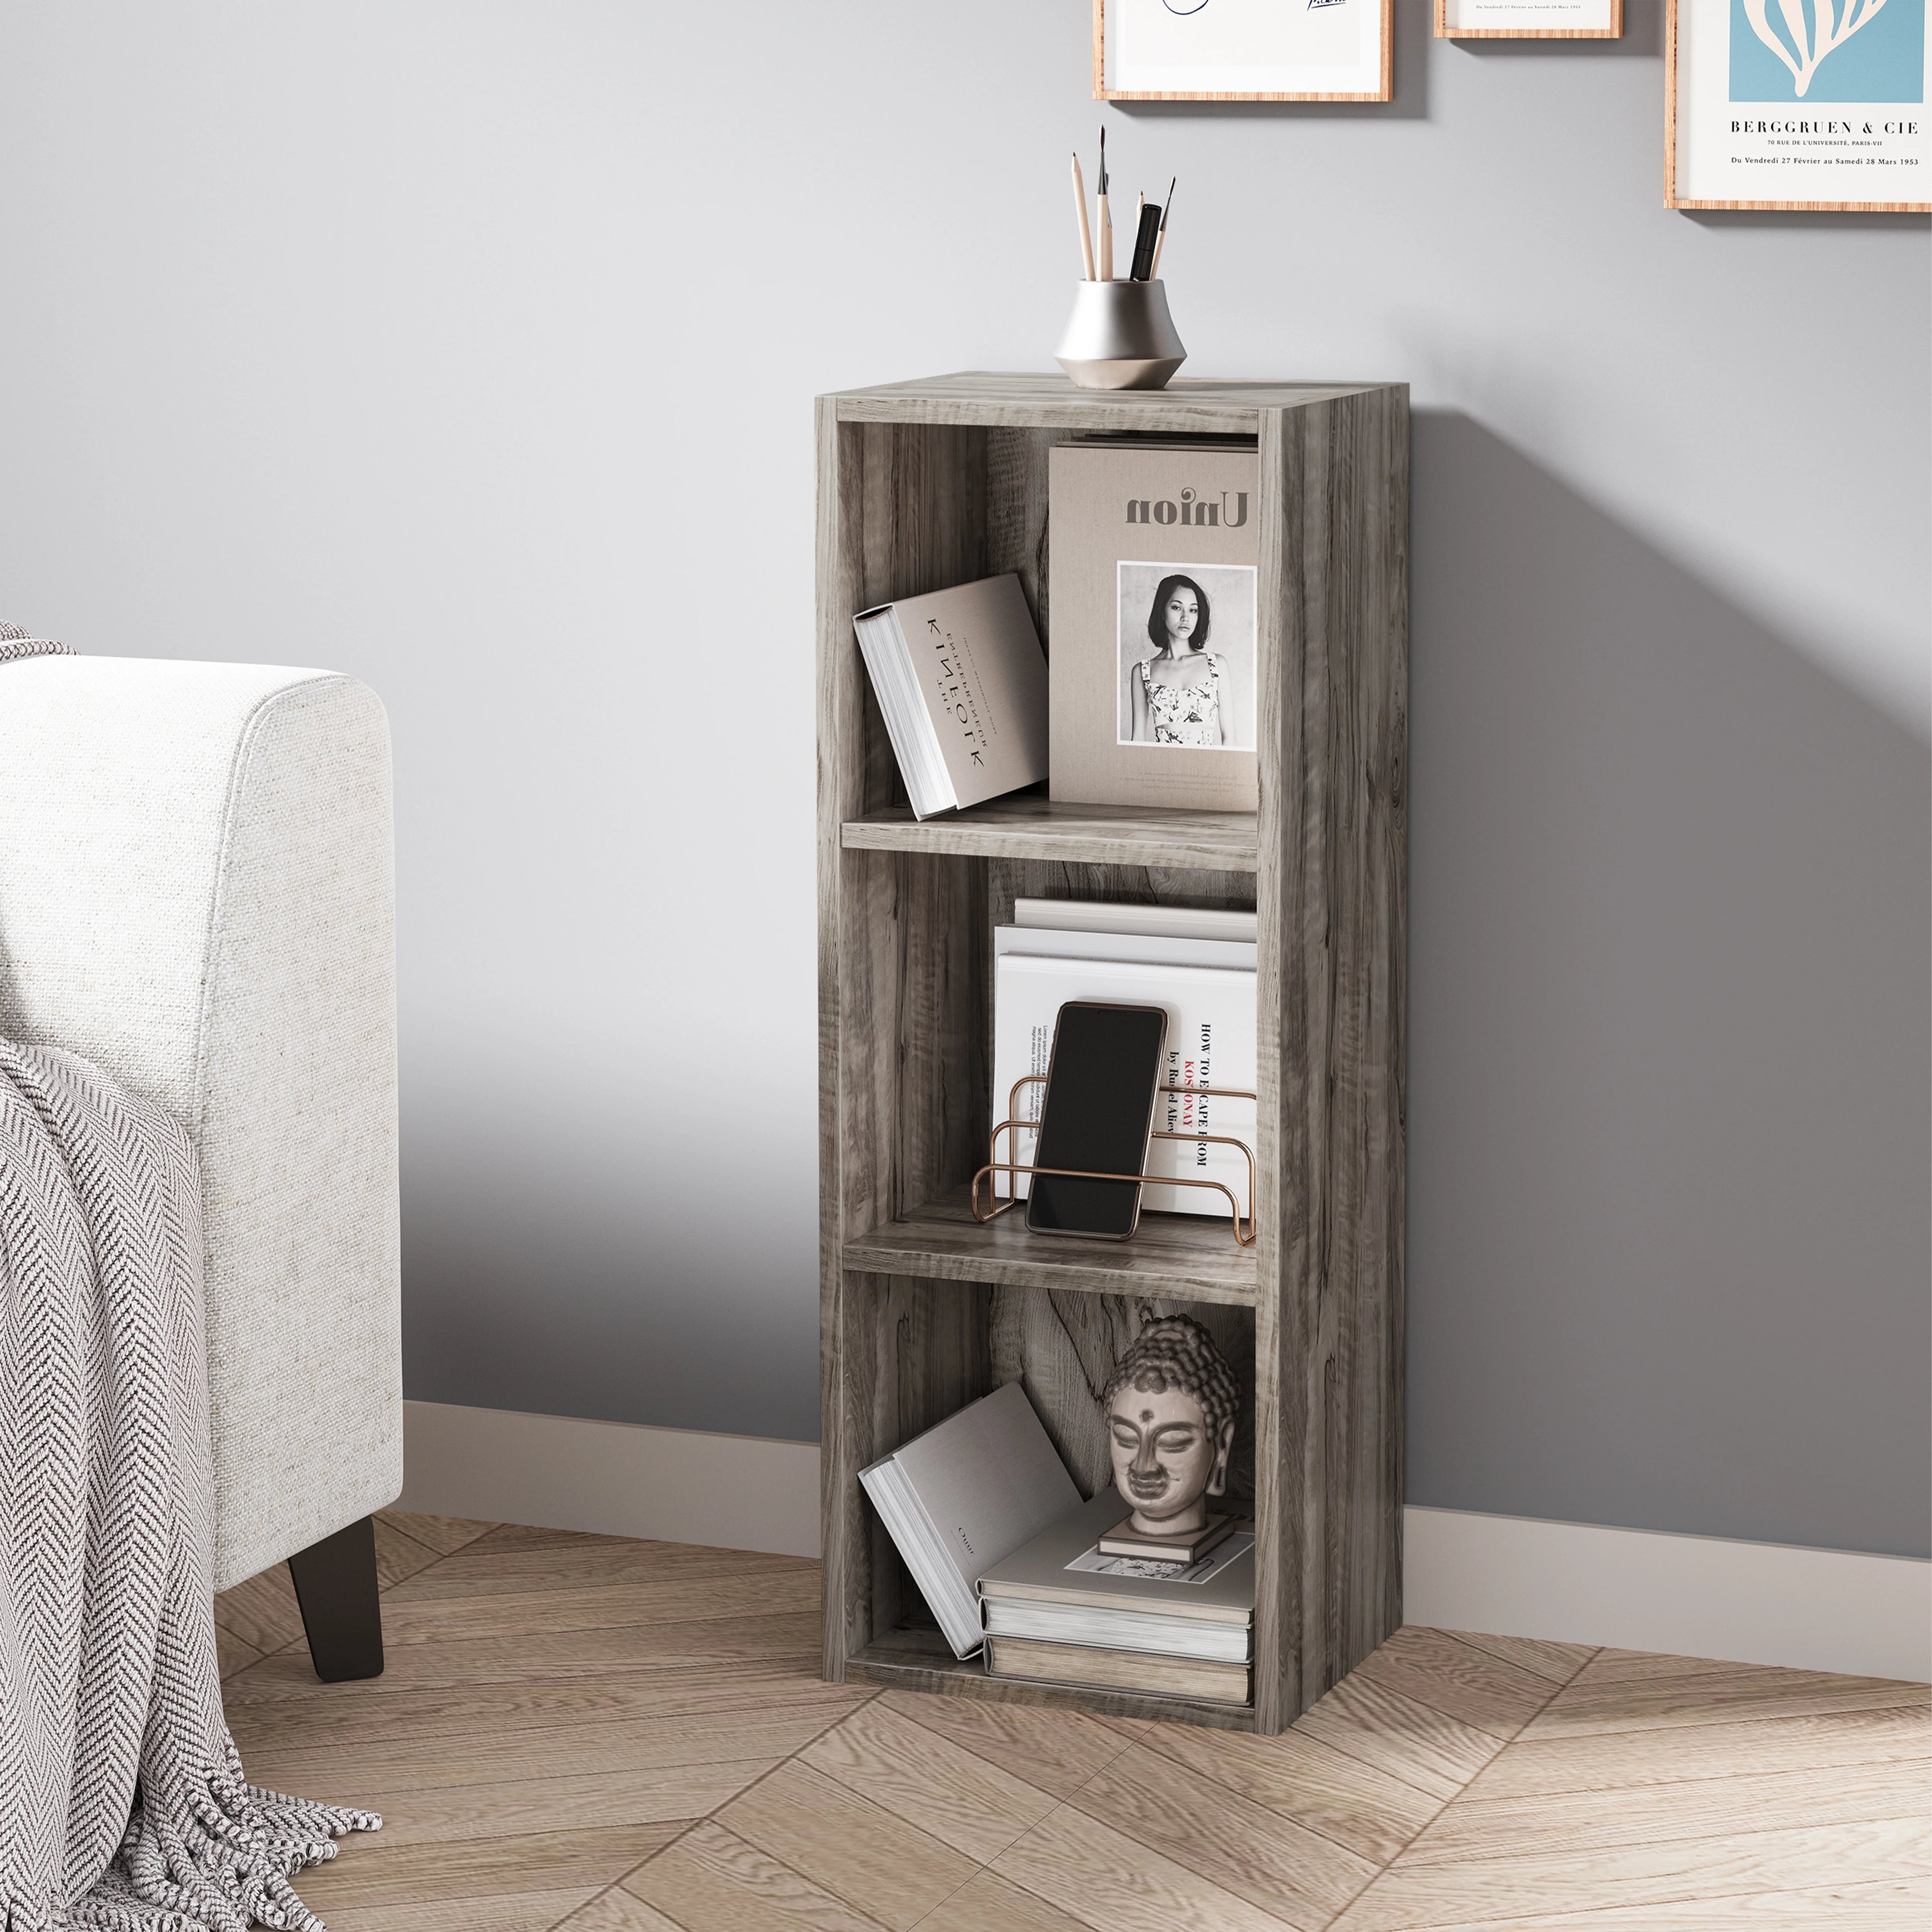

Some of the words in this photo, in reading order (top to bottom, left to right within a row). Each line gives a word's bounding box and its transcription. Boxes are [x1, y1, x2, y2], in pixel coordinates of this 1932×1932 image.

[1731, 120, 1852, 134] BERGGRUEN
[1863, 121, 1873, 134] &
[1884, 122, 1918, 134] CIE
[1200, 1023, 1211, 1054] HOW
[1167, 1052, 1179, 1065] by
[1200, 1058, 1210, 1076] TO
[1183, 1061, 1194, 1128] KOSONAY
[1198, 1080, 1209, 1127] ECAPE
